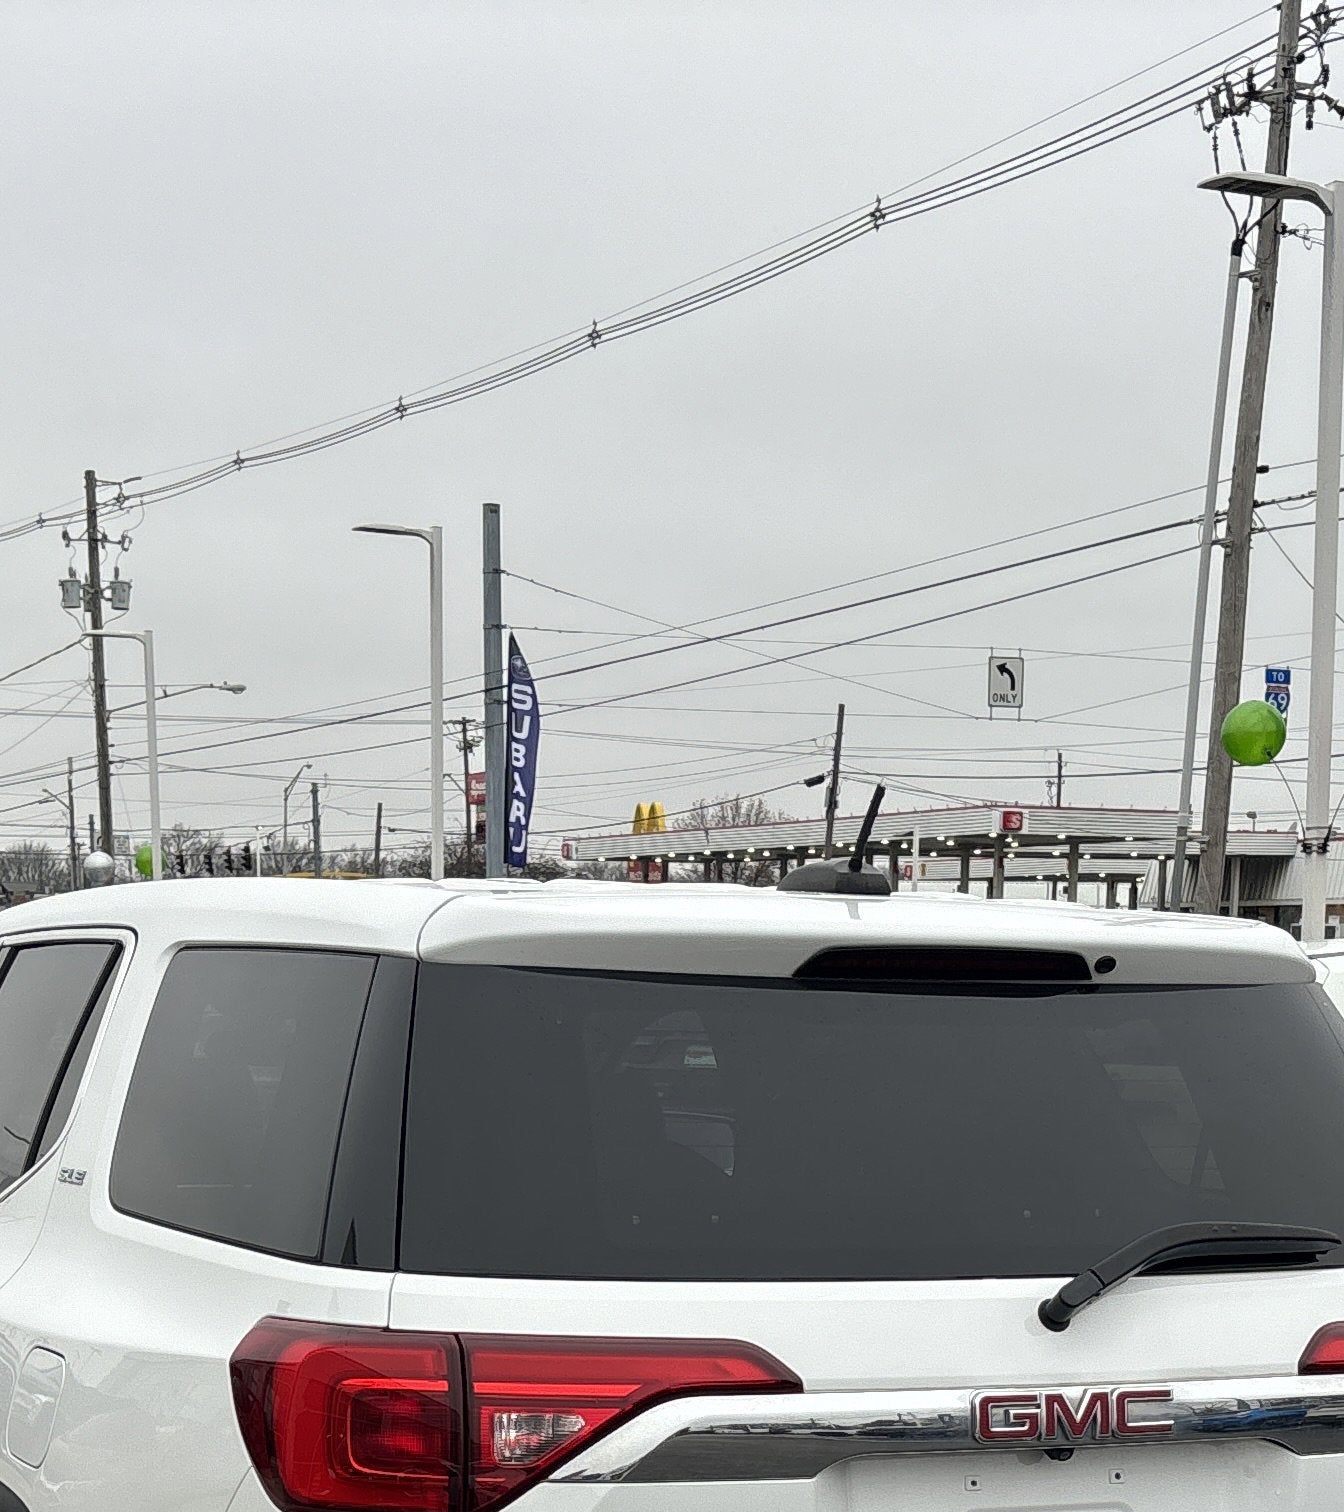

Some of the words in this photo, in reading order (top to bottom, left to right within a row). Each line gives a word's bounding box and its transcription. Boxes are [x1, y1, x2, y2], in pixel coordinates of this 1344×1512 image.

[1271, 671, 1285, 682] TO
[992, 693, 1018, 704] ONLY
[509, 682, 533, 853] SUBARU
[974, 1385, 1175, 1444] GMC
